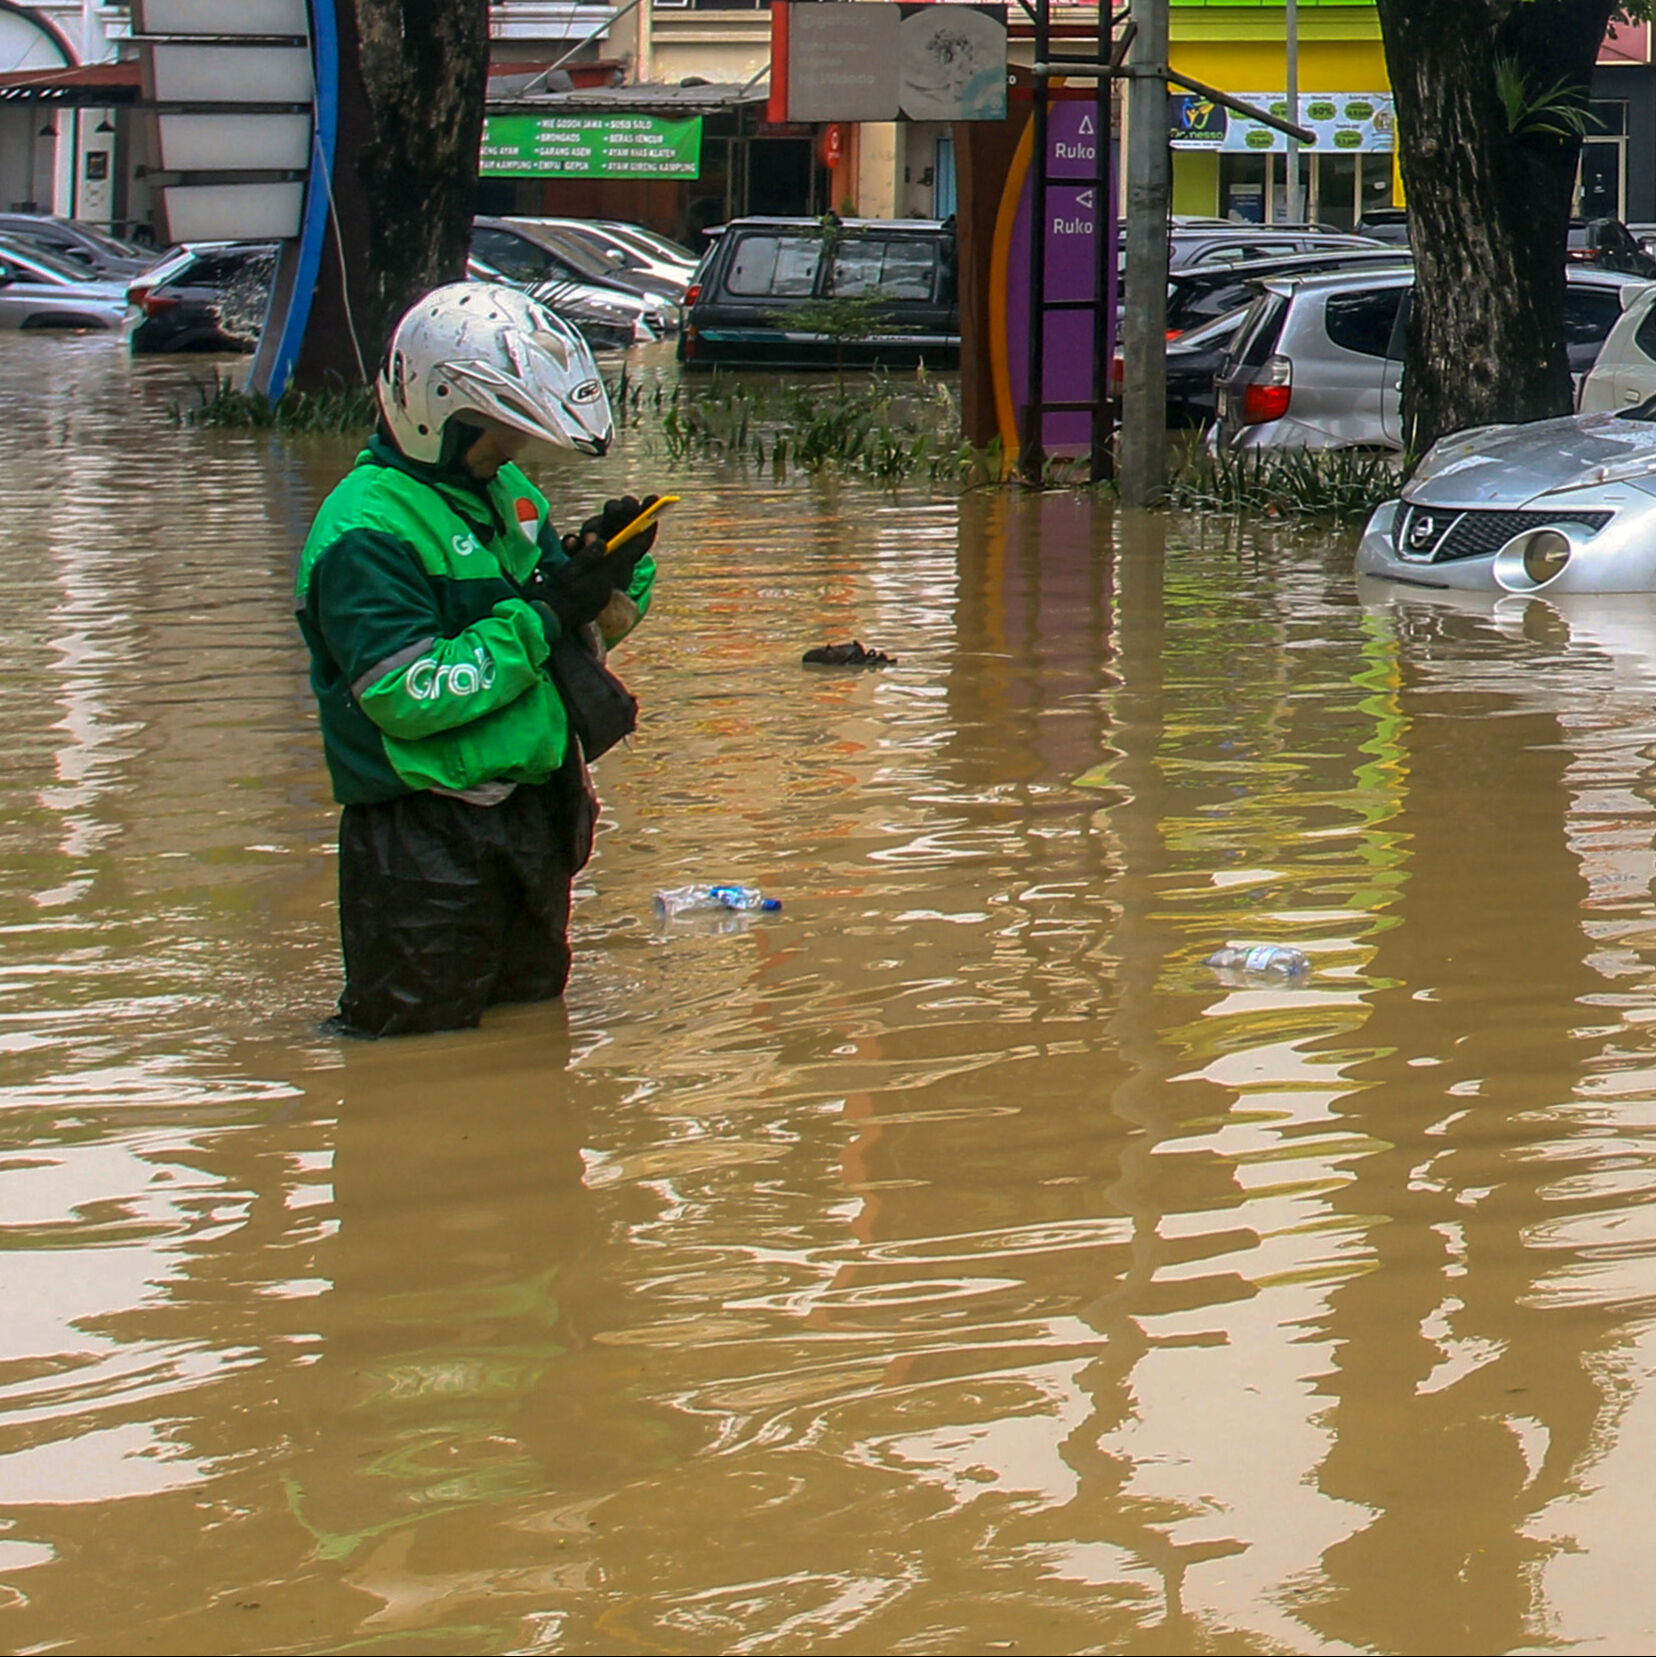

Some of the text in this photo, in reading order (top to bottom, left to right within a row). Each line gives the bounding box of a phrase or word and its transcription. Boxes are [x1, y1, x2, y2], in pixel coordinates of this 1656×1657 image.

[1055, 142, 1096, 160] Ruko
[1053, 218, 1094, 235] Ruko
[405, 646, 497, 701] Grab
